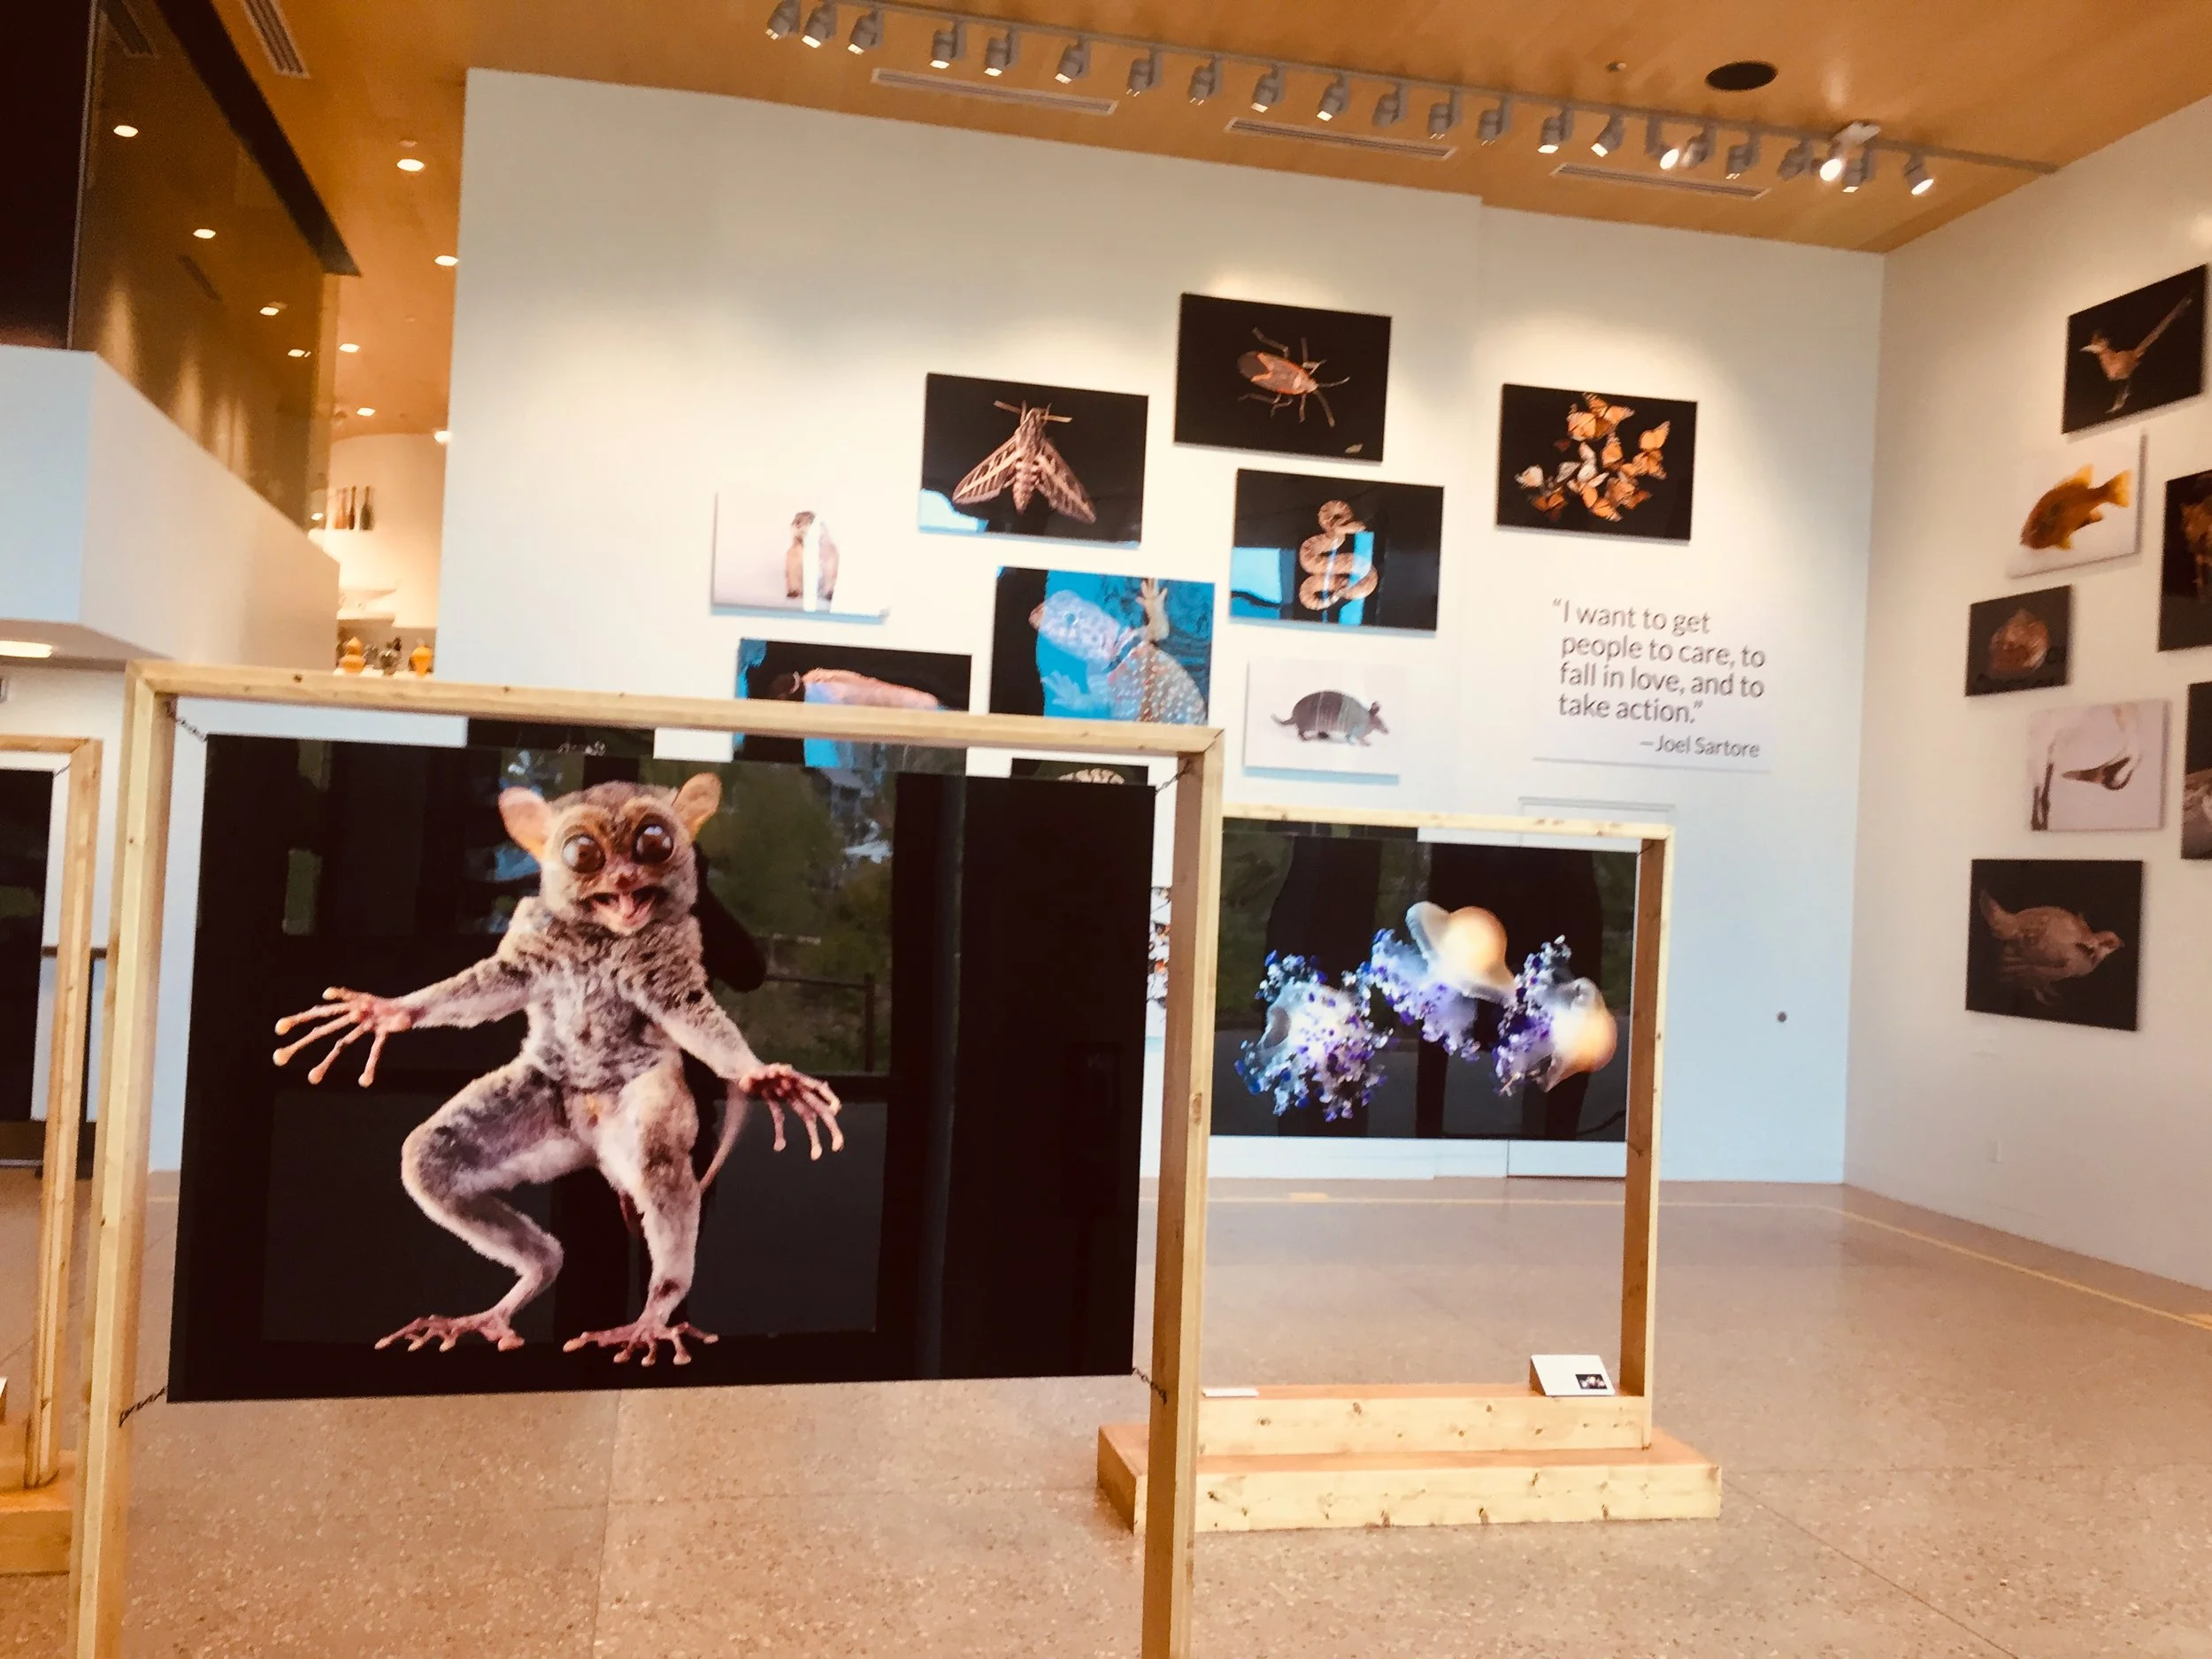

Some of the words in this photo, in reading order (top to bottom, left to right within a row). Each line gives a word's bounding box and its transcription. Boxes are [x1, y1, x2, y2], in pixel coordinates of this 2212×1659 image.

[1576, 607, 1636, 629] want
[1642, 608, 1668, 630] to
[1671, 612, 1711, 637] get
[1561, 634, 1643, 662] people
[1648, 639, 1674, 662] to
[1678, 644, 1735, 669] care,
[1741, 644, 1766, 668] to
[1560, 661, 1596, 687] fall
[1603, 664, 1624, 688] in
[1631, 665, 1686, 695] love,
[1690, 672, 1734, 696] and
[1740, 675, 1765, 698] to
[1558, 693, 1610, 718] take
[1694, 736, 1760, 758] Sartore
